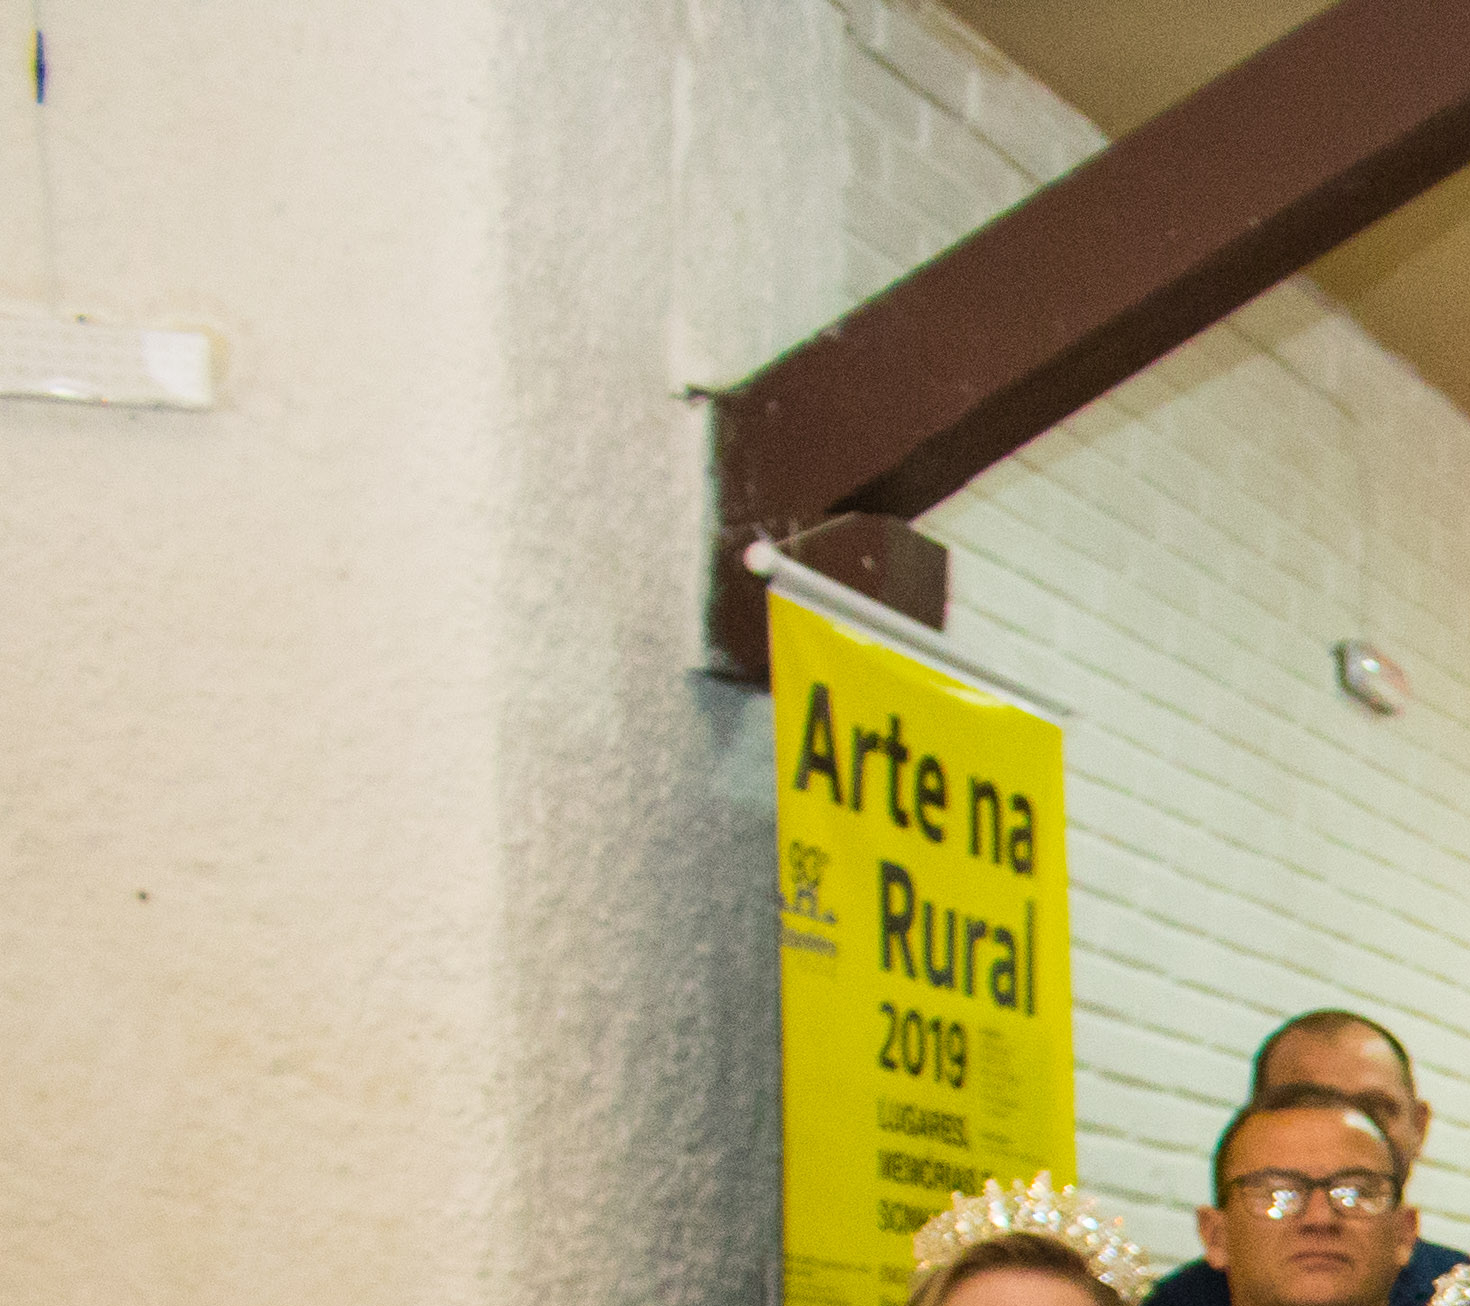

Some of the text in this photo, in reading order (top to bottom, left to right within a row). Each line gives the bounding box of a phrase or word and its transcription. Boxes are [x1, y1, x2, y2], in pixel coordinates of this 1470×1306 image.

[794, 681, 1037, 876] Arte na
[877, 858, 1037, 1017] Rural
[877, 1001, 967, 1089] 2019
